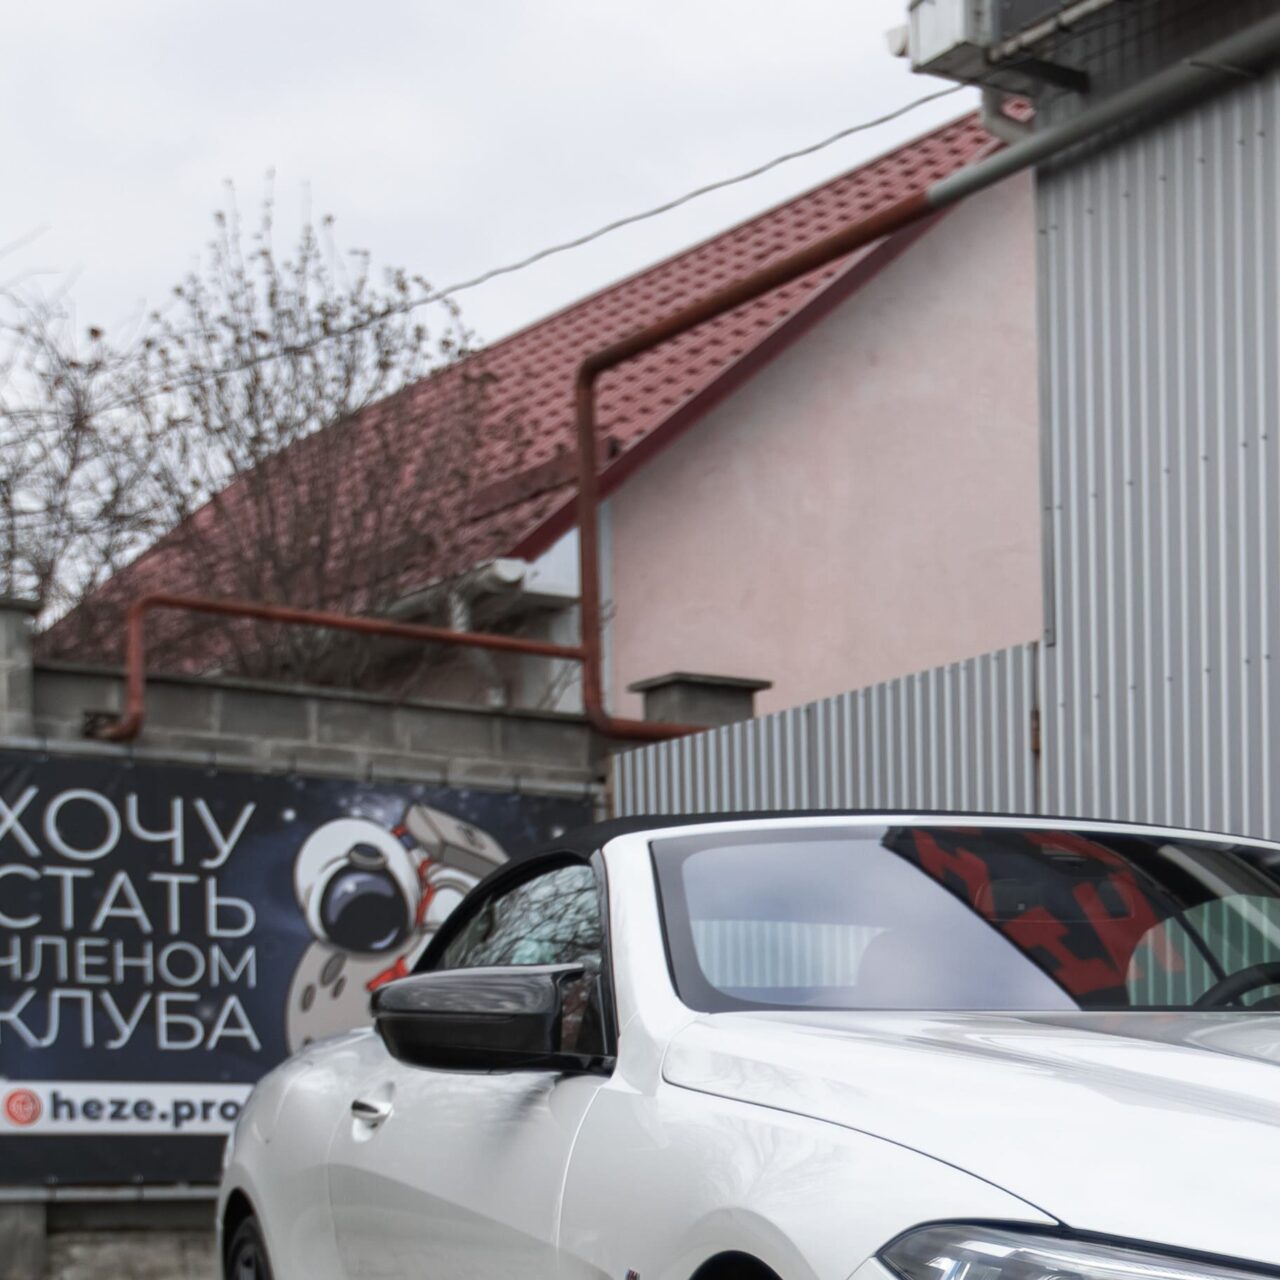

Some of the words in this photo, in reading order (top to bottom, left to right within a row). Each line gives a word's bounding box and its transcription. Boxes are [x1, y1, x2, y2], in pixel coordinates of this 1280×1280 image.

[0, 785, 256, 869] ХОЧУ
[0, 863, 257, 938] СТАТЬ
[0, 986, 261, 1051] КЛУБА
[50, 1090, 241, 1128] heze.pro
